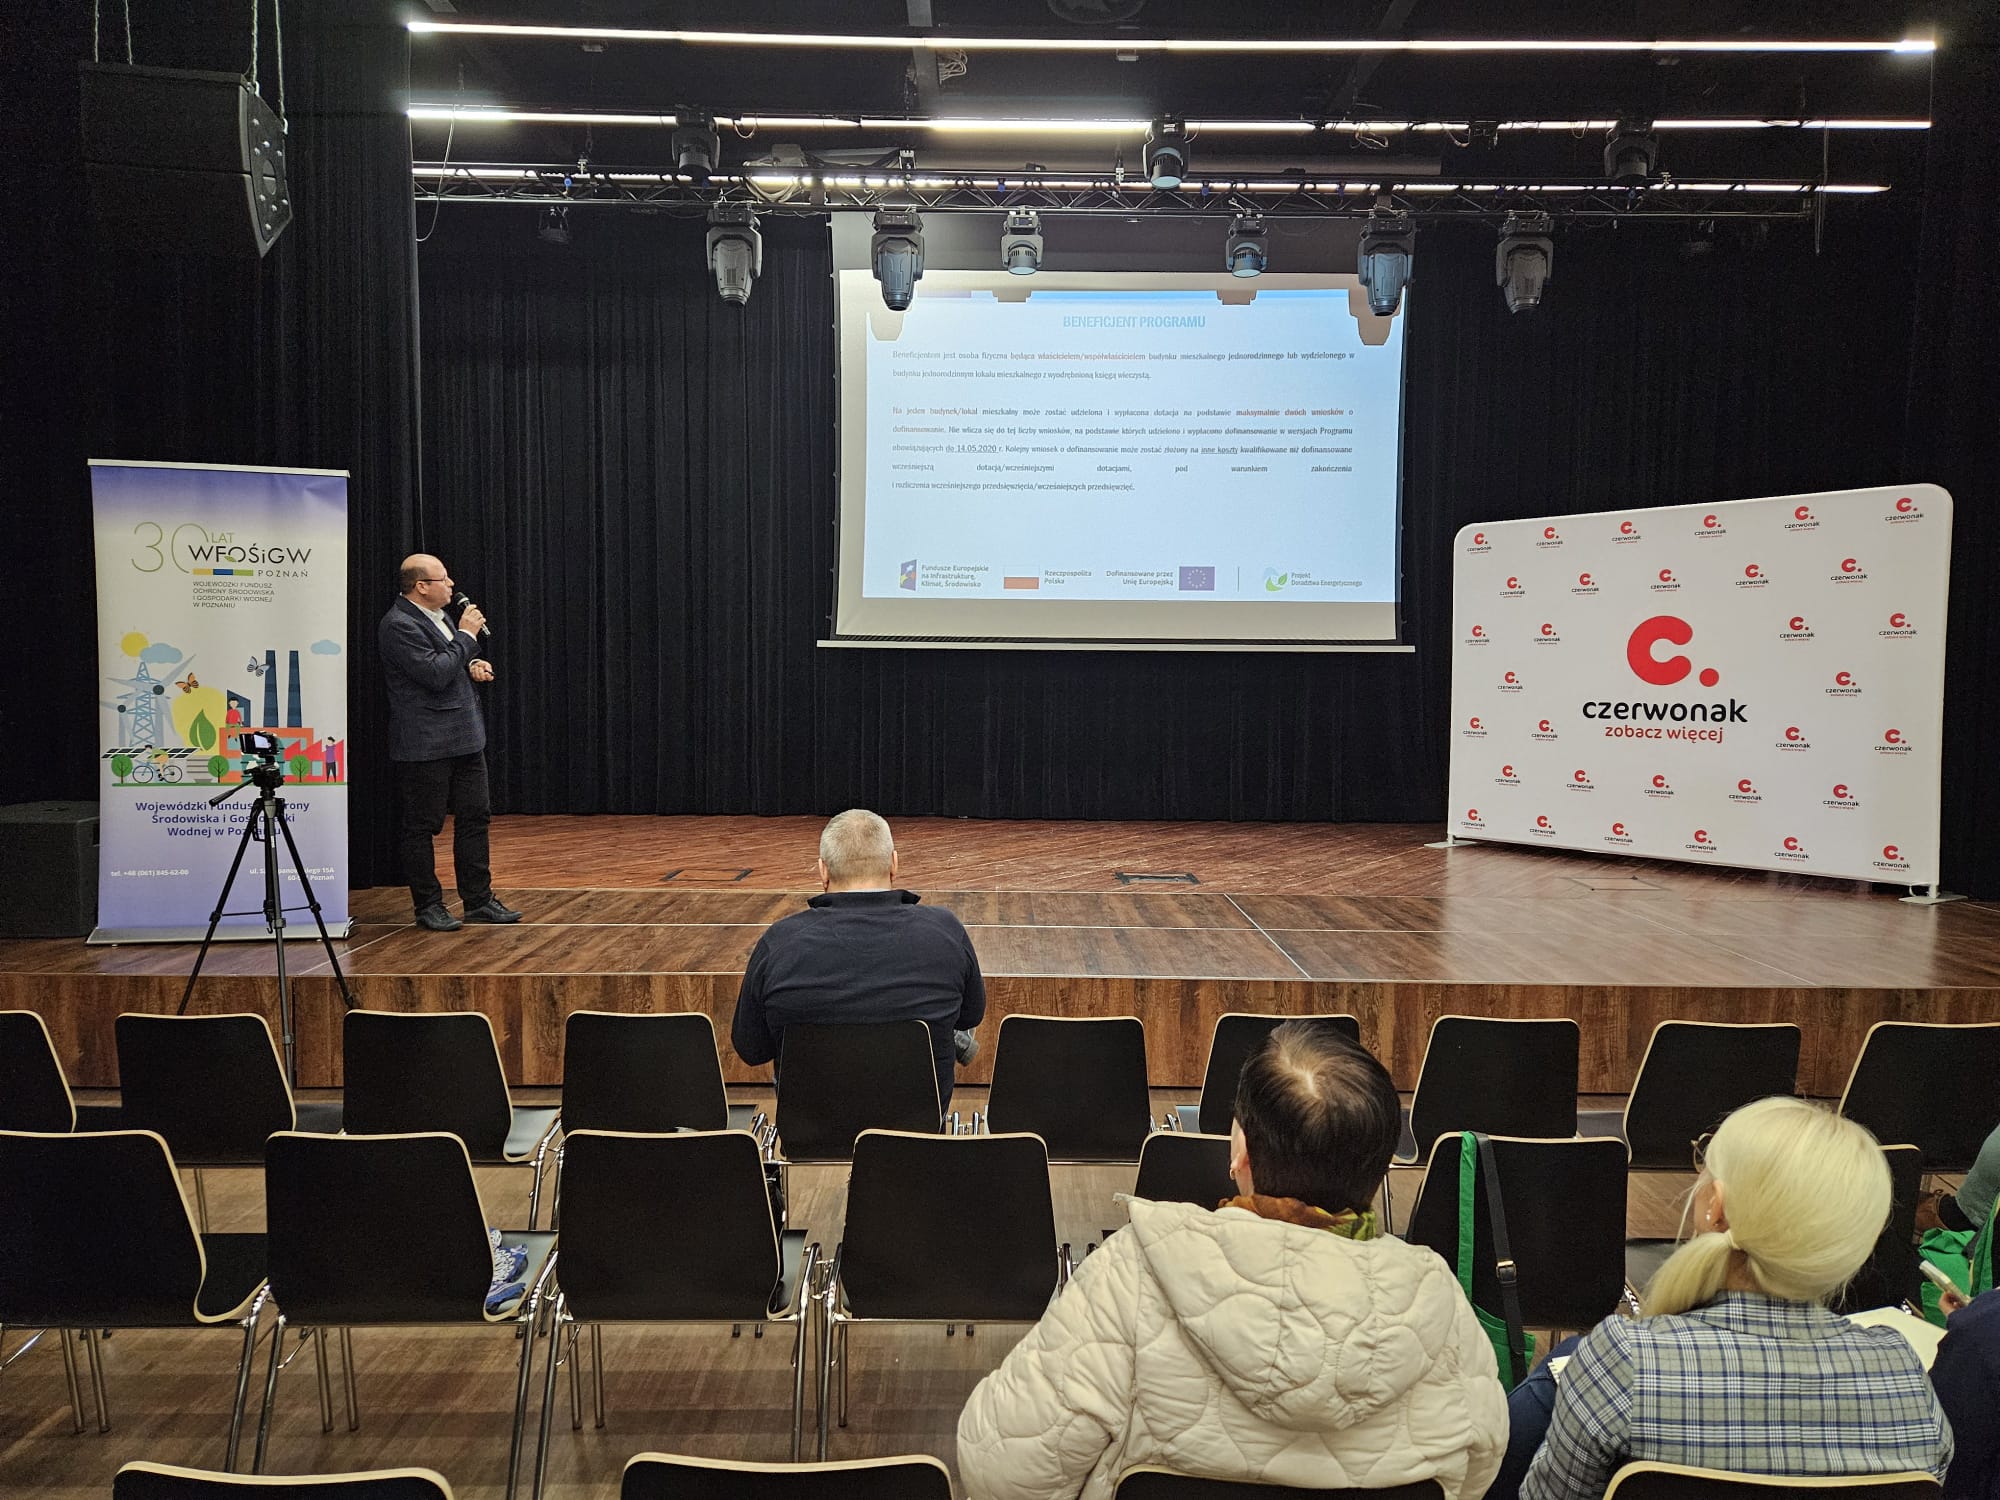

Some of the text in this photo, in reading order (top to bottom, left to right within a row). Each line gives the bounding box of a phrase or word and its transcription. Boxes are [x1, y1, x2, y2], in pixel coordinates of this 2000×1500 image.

[1064, 316, 1206, 327] BENEFICJENT PROGRAMU
[893, 351, 941, 360] Beneficjentem
[943, 352, 956, 360] jest
[982, 352, 1008, 360] fizyczna
[1149, 352, 1178, 360] budynku
[1180, 352, 1226, 361] mieszkalnego
[1228, 352, 1285, 360] jednorodzinnego
[1301, 352, 1347, 360] wydzielonego
[922, 370, 975, 378] jednorodzinnym
[997, 371, 1042, 379] mieszkalnego
[1095, 372, 1118, 380] księgą
[907, 408, 926, 416] jeden
[930, 408, 978, 416] budynek/lokal
[982, 408, 1019, 416] mieszkalny
[1114, 409, 1150, 417] wypłacona
[1154, 409, 1179, 417] dotacja
[1197, 409, 1232, 417] podstawie
[1236, 409, 1281, 417] maksymalnie
[1018, 427, 1037, 435] liczby
[1085, 427, 1120, 435] podstawie
[1122, 427, 1147, 435] których
[1288, 428, 1318, 436] wersjach
[1320, 427, 1353, 436] Programu
[957, 445, 998, 453] 14.05.2020
[1005, 445, 1030, 454] Kolejny
[1218, 447, 1239, 455] koszty
[931, 482, 982, 490] wcześniejszego
[211, 532, 235, 543] LAT
[258, 569, 309, 578] POZNAŃ
[953, 565, 989, 573] Europejskie
[1044, 569, 1092, 578] Rzeczpospolita
[1155, 571, 1173, 579] przez
[1122, 578, 1174, 586] Unię Europejską
[1582, 698, 1748, 724] czerwonak
[1604, 723, 1724, 744] zobacz więcej
[135, 801, 207, 812] Wojewódzki
[151, 813, 220, 824] Środowiska
[222, 814, 226, 823] i
[167, 827, 211, 838] Wodnej
